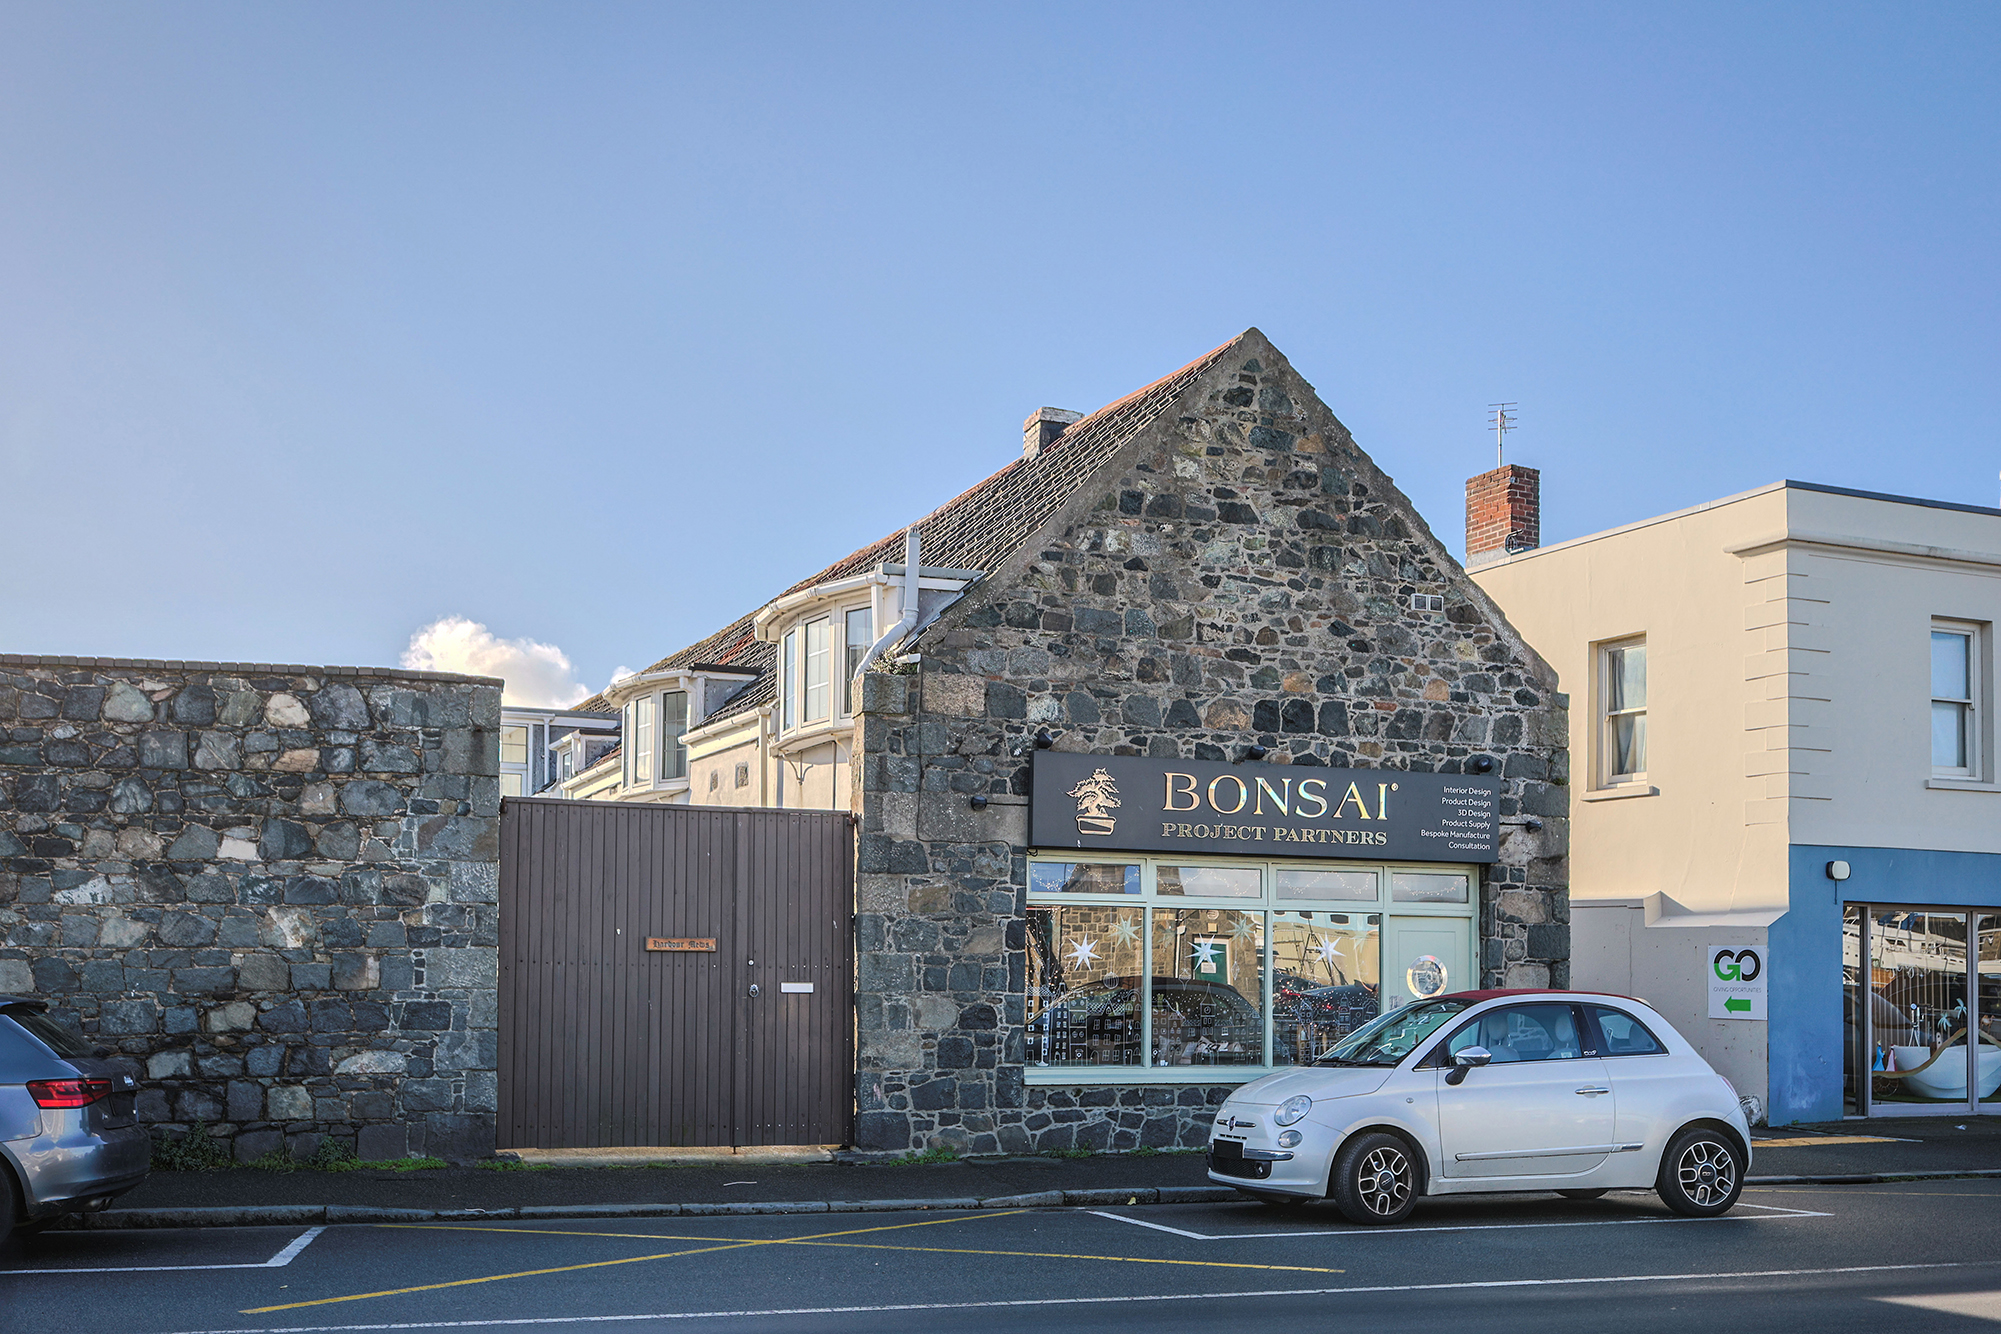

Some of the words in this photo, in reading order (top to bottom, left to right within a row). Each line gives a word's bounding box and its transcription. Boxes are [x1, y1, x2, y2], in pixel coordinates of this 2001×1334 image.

[1443, 786, 1468, 794] Interior
[1468, 787, 1492, 797] Design
[1441, 797, 1468, 806] Product
[1468, 798, 1491, 808] Design
[1457, 809, 1467, 817] 3D
[1468, 809, 1491, 819] Design
[1441, 819, 1468, 828] Product
[1468, 820, 1491, 830] Supply
[1161, 822, 1267, 841] PROJECT
[1273, 827, 1388, 846] PARTNERS
[1420, 829, 1449, 838] Bespoke
[1450, 830, 1491, 840] Manufacture
[1448, 841, 1491, 850] Consultation
[1713, 949, 1761, 981] GO
